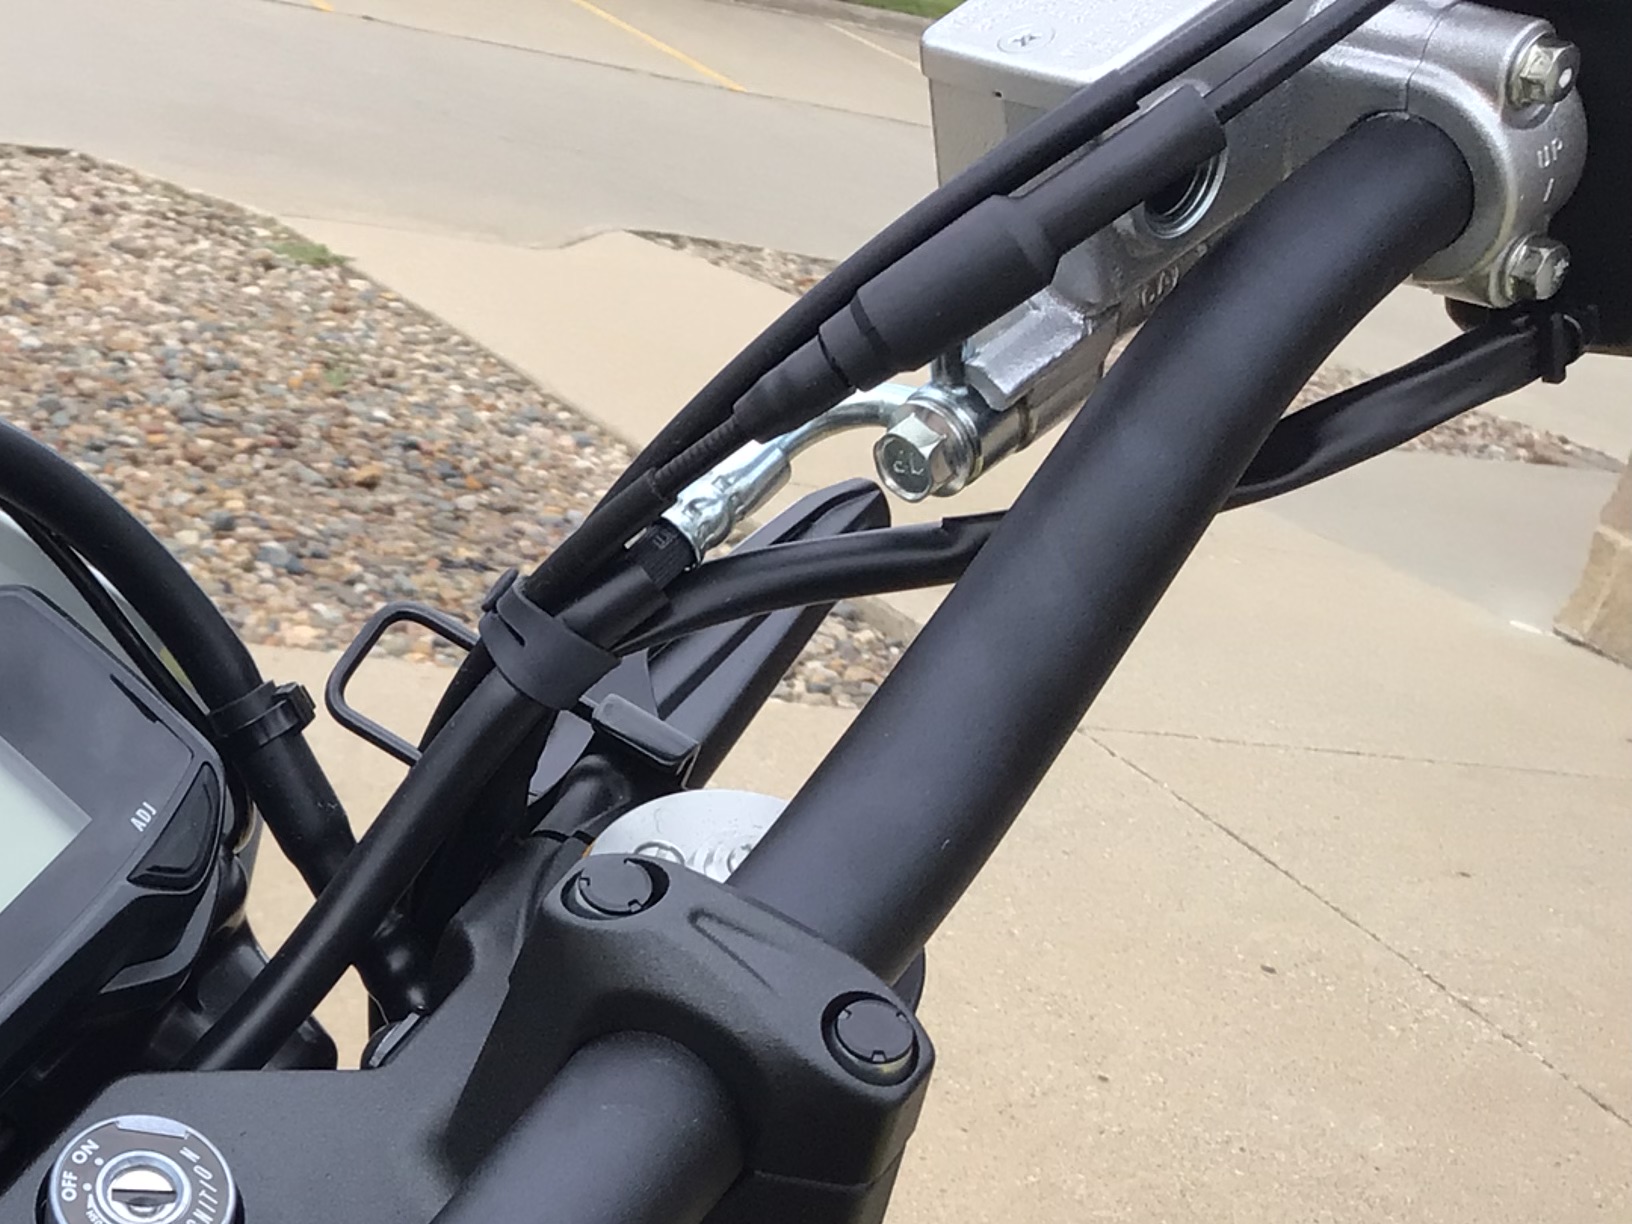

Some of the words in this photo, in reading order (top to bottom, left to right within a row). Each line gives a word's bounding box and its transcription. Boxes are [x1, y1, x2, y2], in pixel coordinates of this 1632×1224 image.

[1537, 137, 1563, 168] UP
[130, 801, 157, 832] ADJ
[71, 1138, 100, 1165] ON
[61, 1170, 78, 1202] OFF
